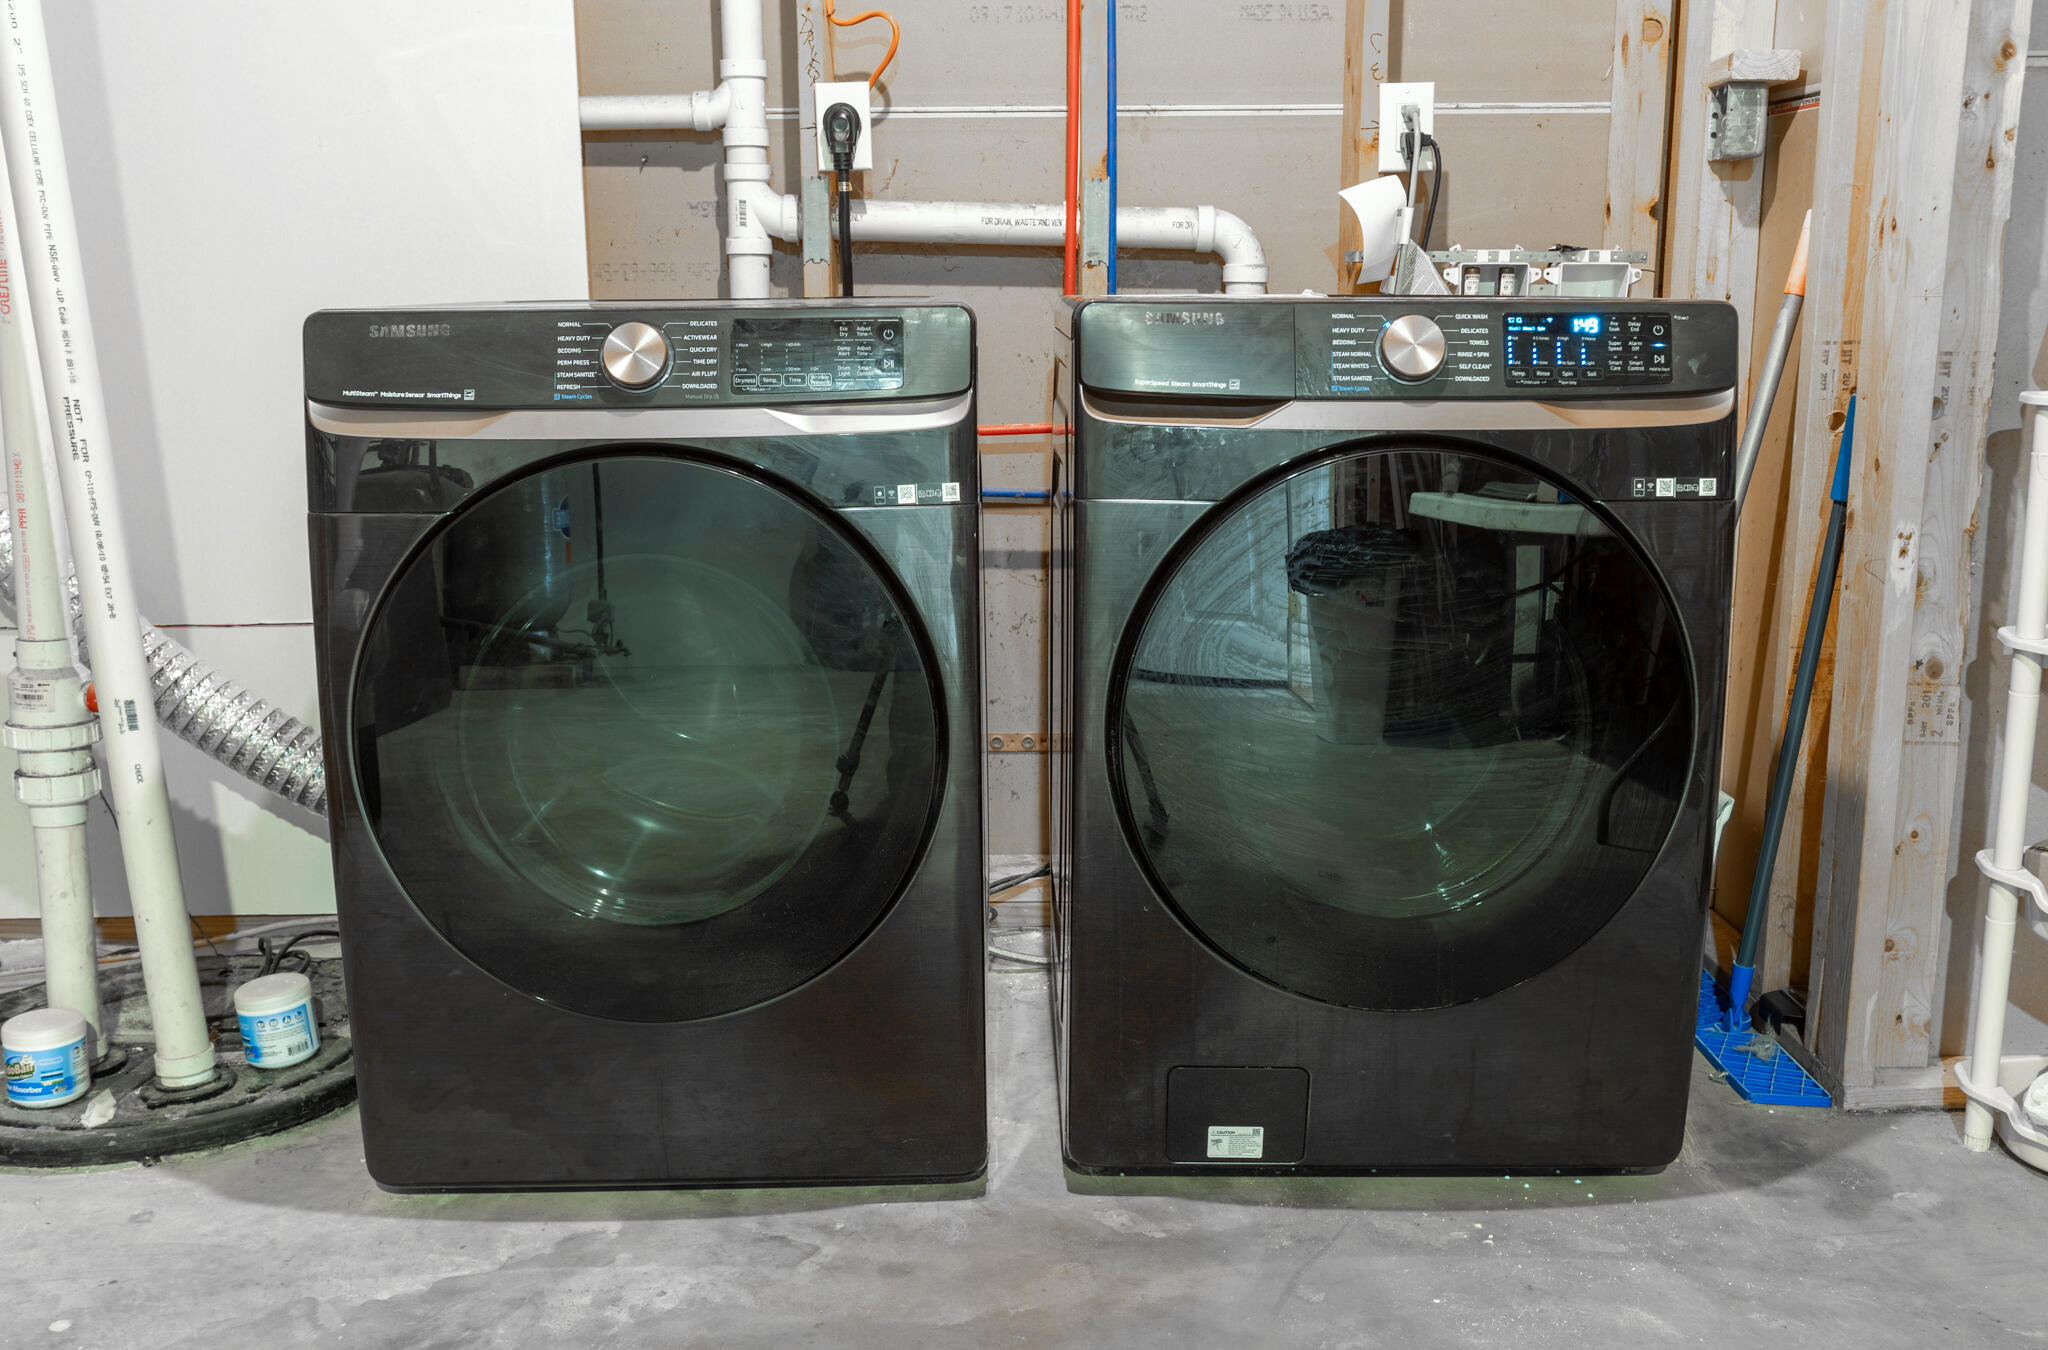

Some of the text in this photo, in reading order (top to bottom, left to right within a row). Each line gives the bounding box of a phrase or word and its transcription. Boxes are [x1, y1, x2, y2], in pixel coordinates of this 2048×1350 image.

[1144, 311, 1225, 326] SAMSUNG
[369, 324, 450, 338] SAMSUNG
[1171, 380, 1190, 388] Steam
[1191, 381, 1227, 390] SmartThings
[380, 390, 404, 398] Moisture
[426, 391, 462, 400] SmartThings
[72, 399, 83, 423] NOT
[63, 396, 80, 461] PRESSURE
[79, 438, 91, 463] FOR
